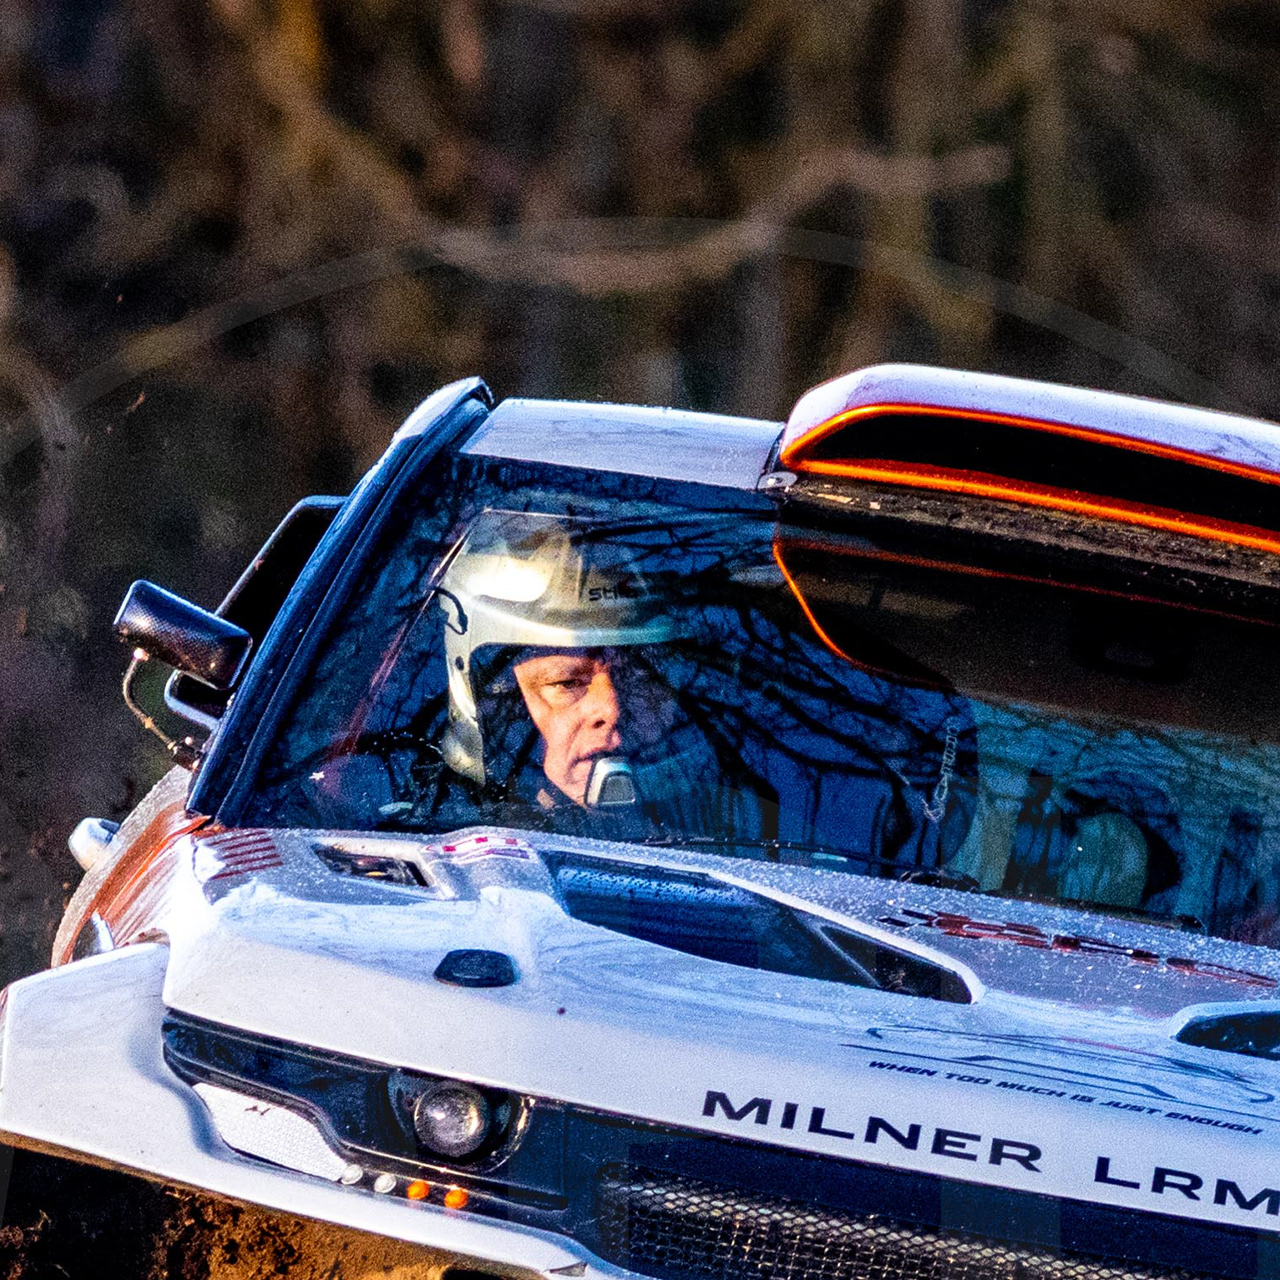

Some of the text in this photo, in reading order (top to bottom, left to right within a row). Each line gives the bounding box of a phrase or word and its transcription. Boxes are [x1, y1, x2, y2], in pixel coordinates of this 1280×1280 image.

[702, 1090, 1043, 1173] MILNER
[867, 1060, 1264, 1136] WHEN TOO MUCH IS JUST ENOUGH
